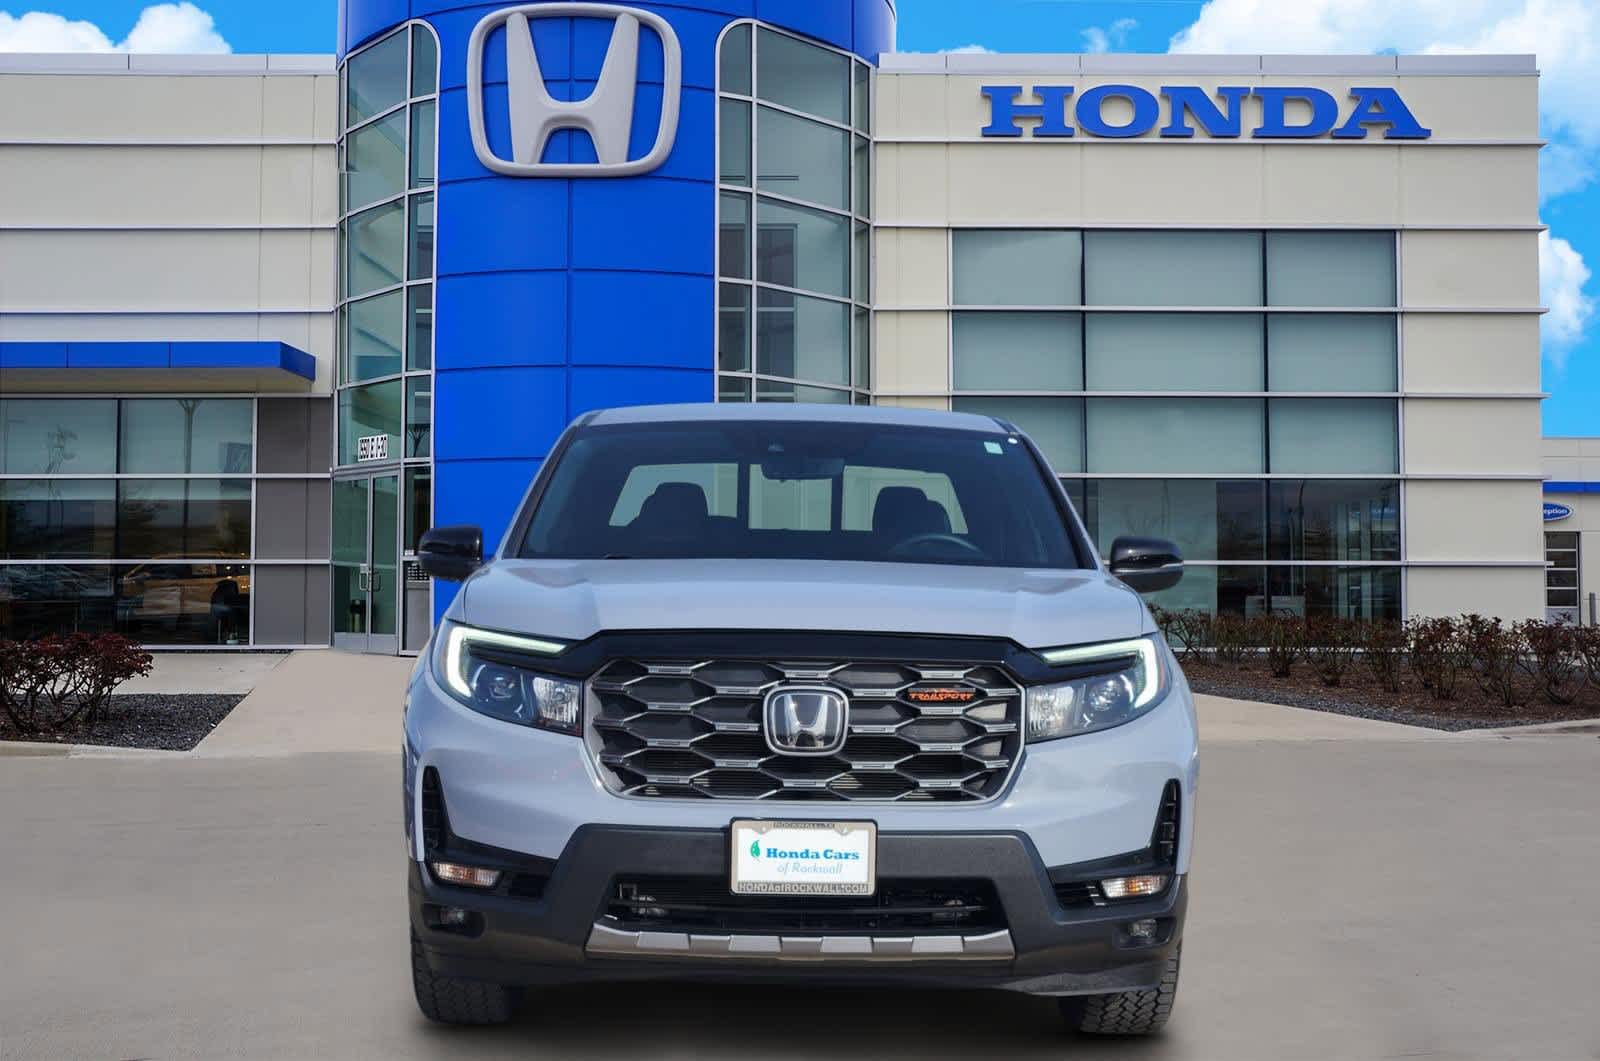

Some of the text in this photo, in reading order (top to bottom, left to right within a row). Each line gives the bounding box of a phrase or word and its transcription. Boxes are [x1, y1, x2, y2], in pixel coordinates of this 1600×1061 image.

[981, 84, 1432, 138] HONDA
[766, 847, 860, 860] Honda Cars
[777, 863, 842, 875] of Rockwall
